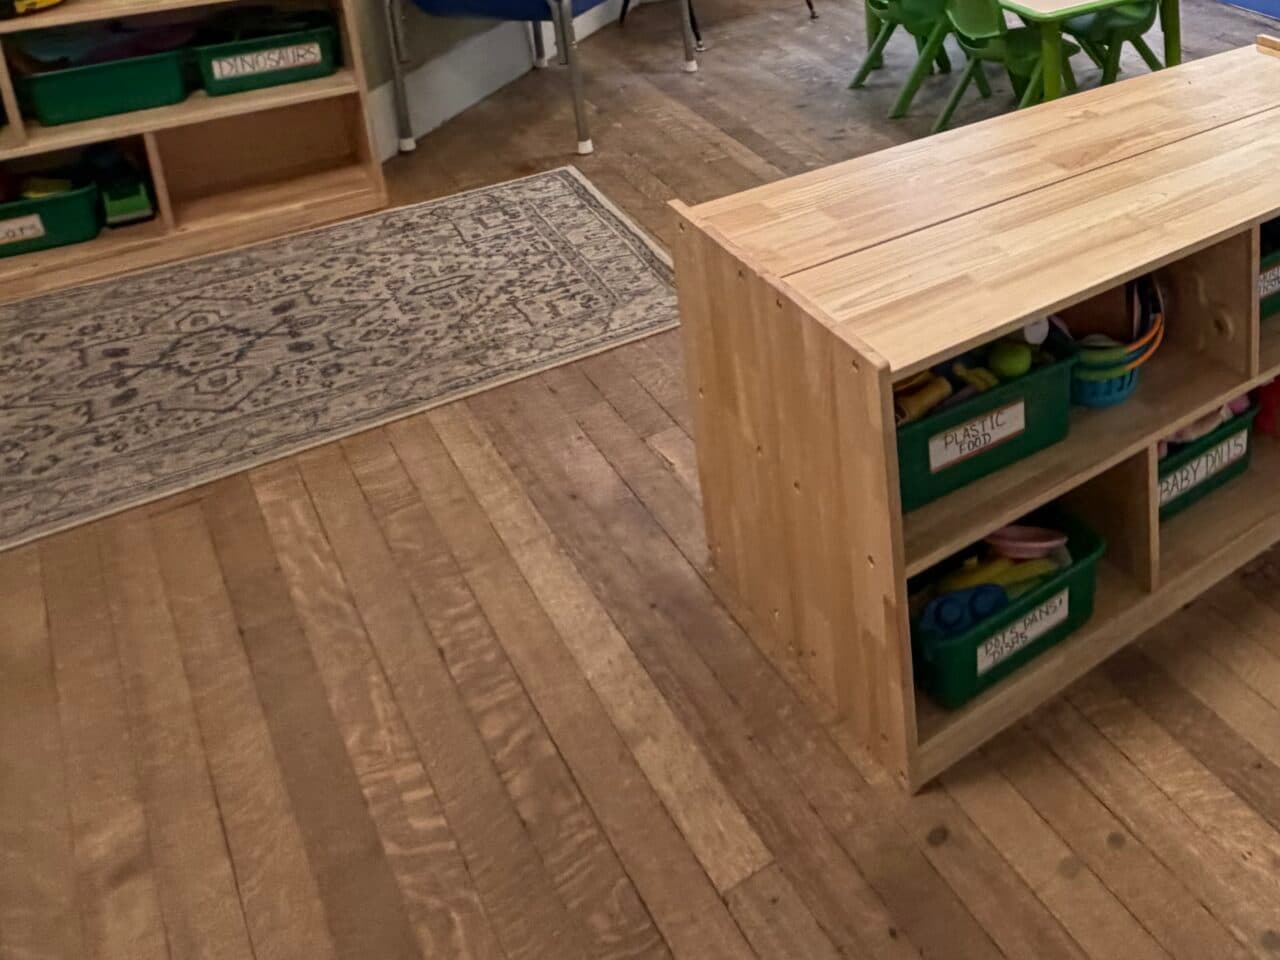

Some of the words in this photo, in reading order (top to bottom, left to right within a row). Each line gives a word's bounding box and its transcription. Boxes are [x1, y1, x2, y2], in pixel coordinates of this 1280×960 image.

[218, 46, 318, 77] DINOSAURS
[944, 411, 1006, 449] PLASTIC
[959, 433, 992, 453] FOOD
[1160, 460, 1201, 498] BABY
